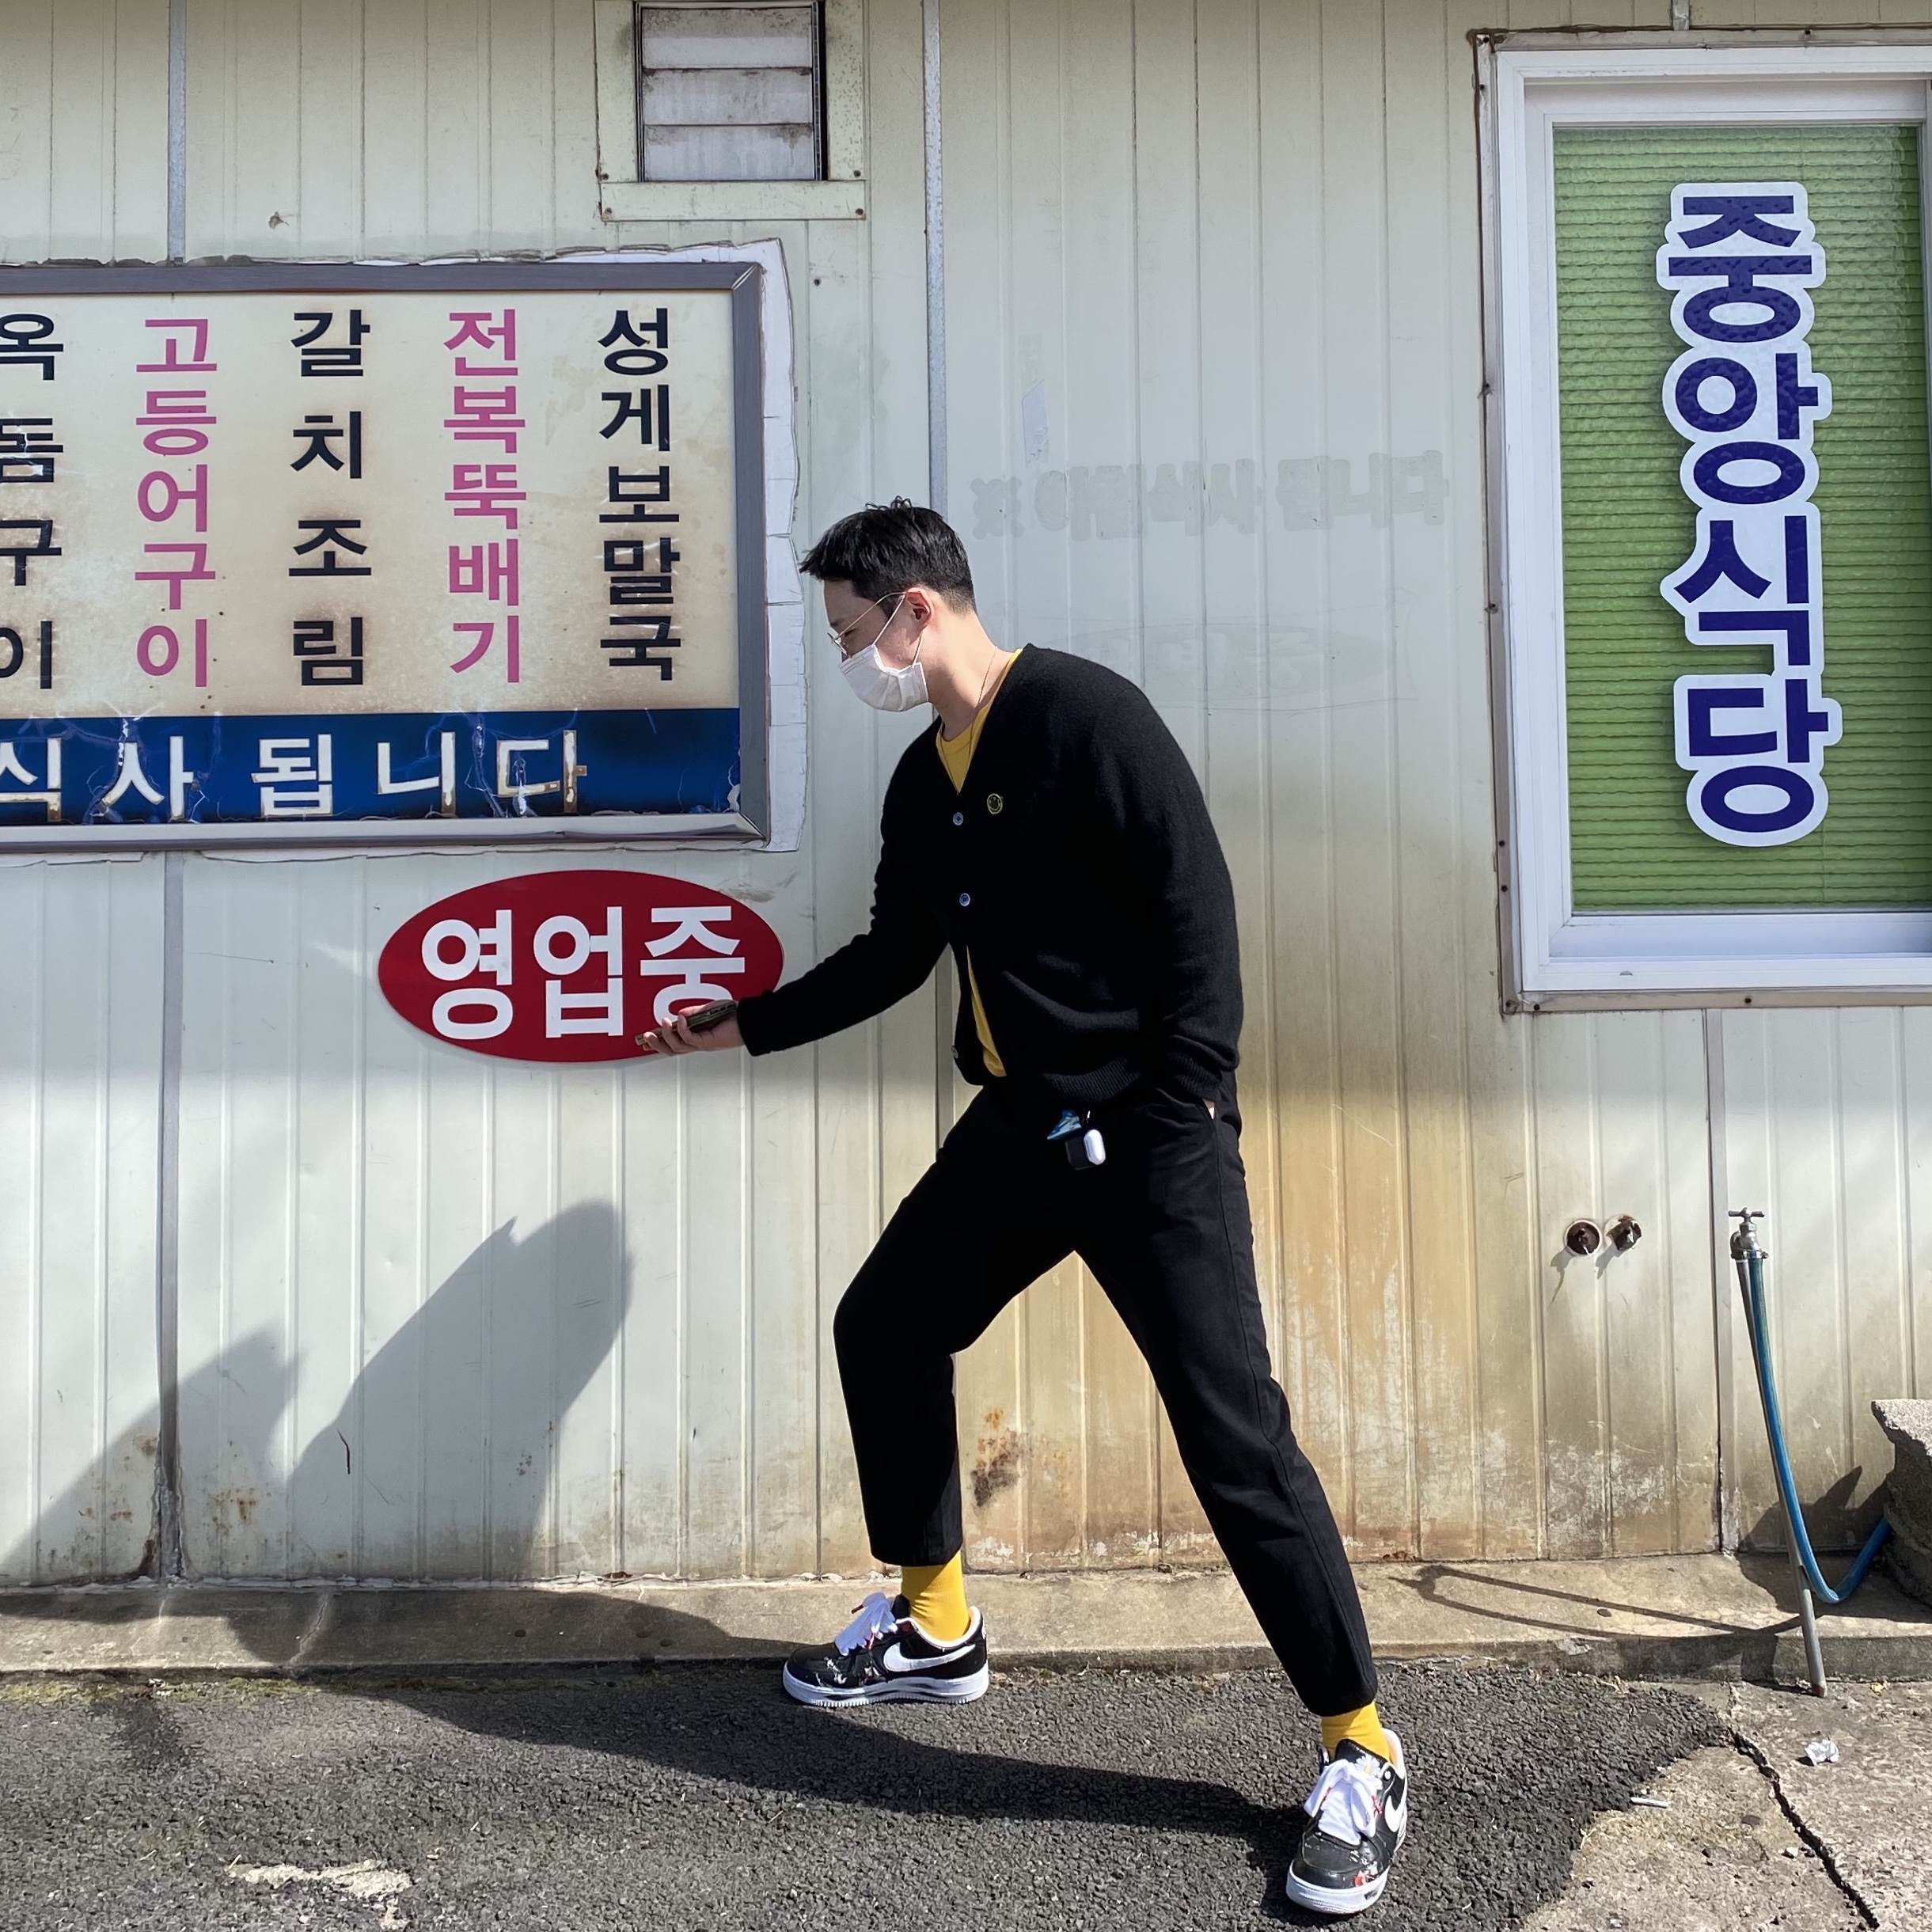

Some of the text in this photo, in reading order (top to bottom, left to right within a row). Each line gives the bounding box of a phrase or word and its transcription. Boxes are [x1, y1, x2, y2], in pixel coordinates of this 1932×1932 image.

[135, 319, 218, 688] 고등어구이
[289, 309, 372, 686] 갈치조림
[444, 309, 526, 683] 전복뚝배기
[598, 307, 681, 681] 성게보말국
[1668, 195, 1829, 833] 중앙식당
[422, 905, 746, 1040] 영업중
